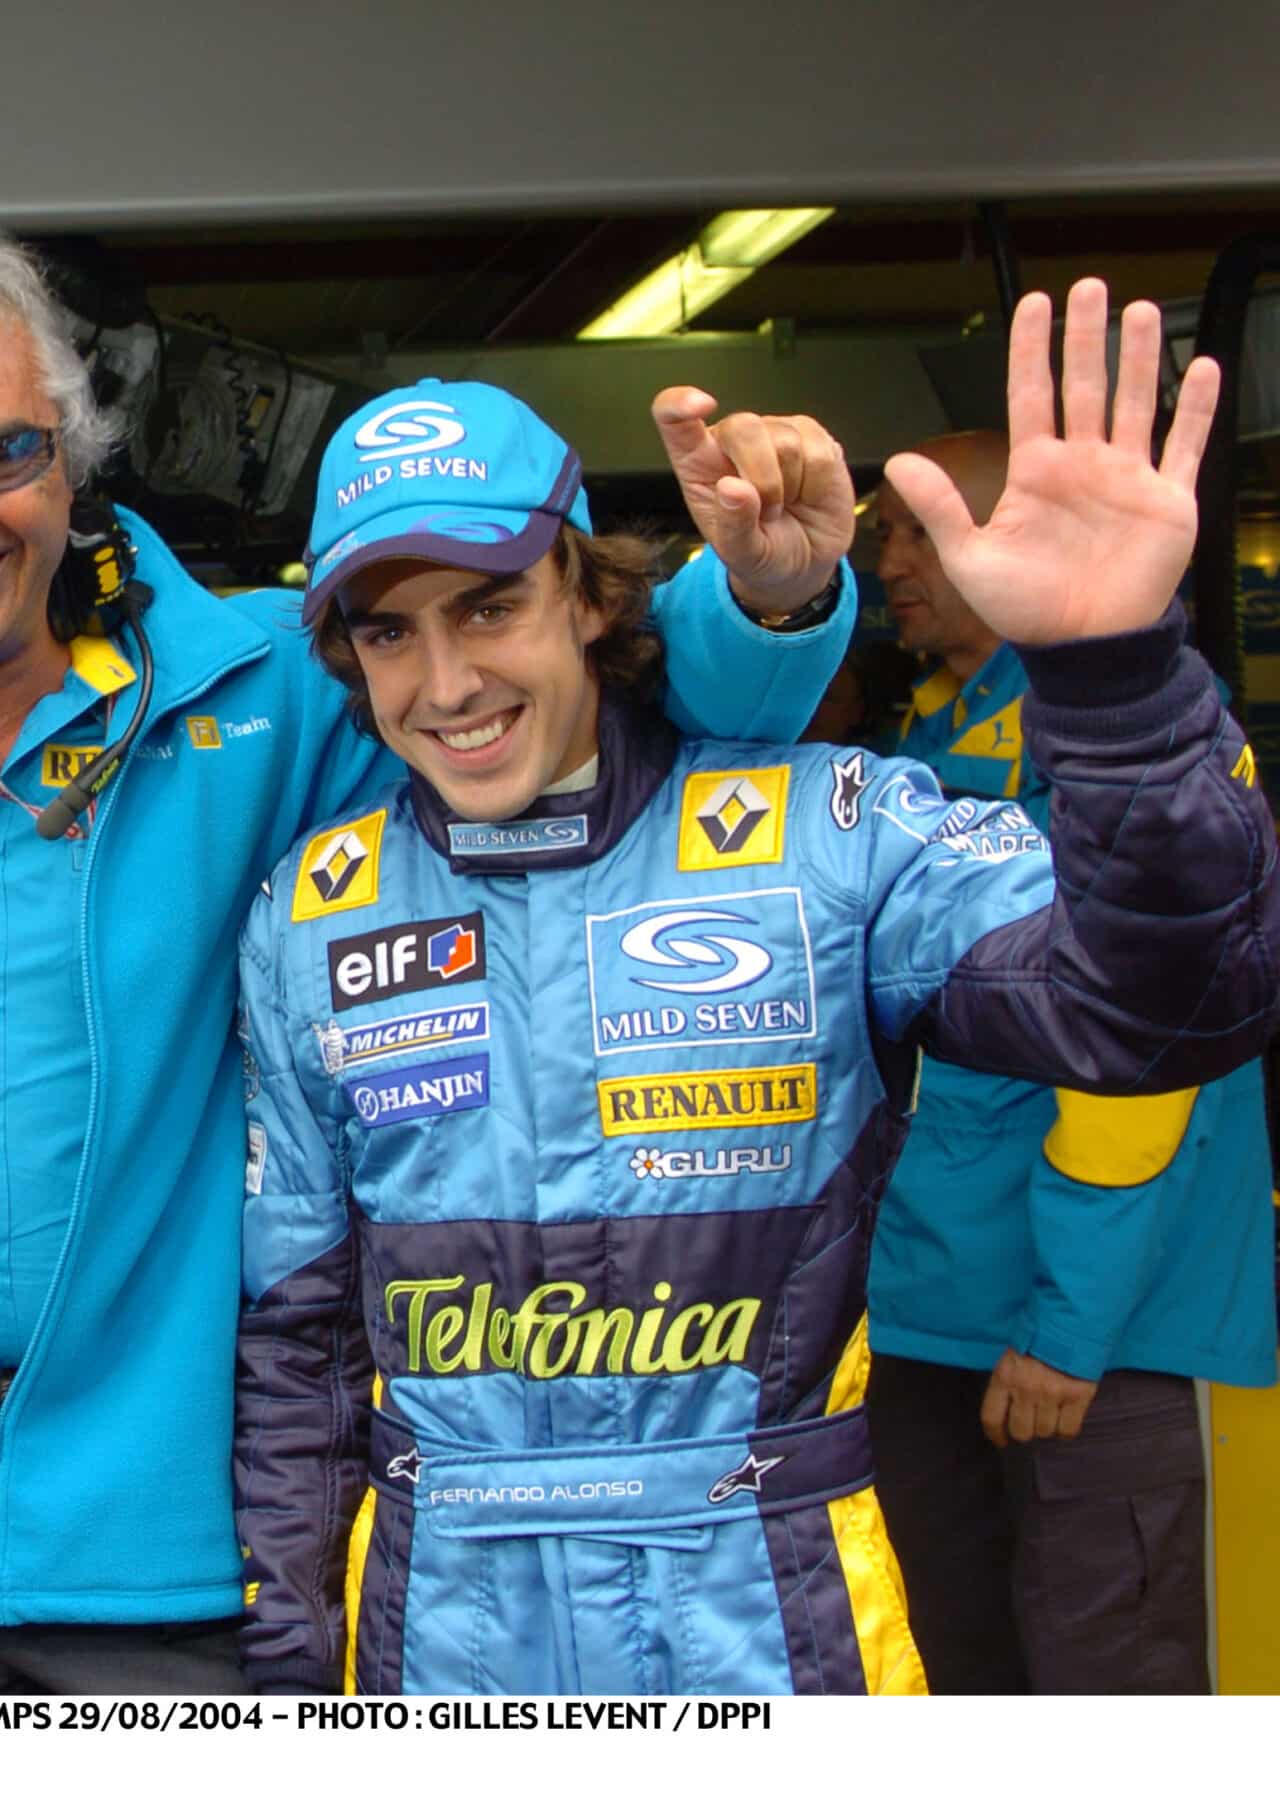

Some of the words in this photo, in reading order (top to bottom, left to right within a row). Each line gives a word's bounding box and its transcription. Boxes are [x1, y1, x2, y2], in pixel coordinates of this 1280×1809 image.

[336, 465, 393, 508] MILD
[400, 457, 488, 481] SEVEN
[455, 833, 487, 847] MILD
[490, 830, 539, 845] SEVEN
[336, 934, 417, 996] elf
[351, 1011, 480, 1054] MICHELIN
[600, 1007, 687, 1043] MILD
[694, 999, 807, 1033] SEVEN
[377, 1070, 484, 1113] HANJIN
[607, 1076, 806, 1124] RENAULT
[662, 1145, 793, 1178] GURU
[430, 1486, 545, 1505] FERNANDO
[551, 1479, 643, 1500] ALONSO
